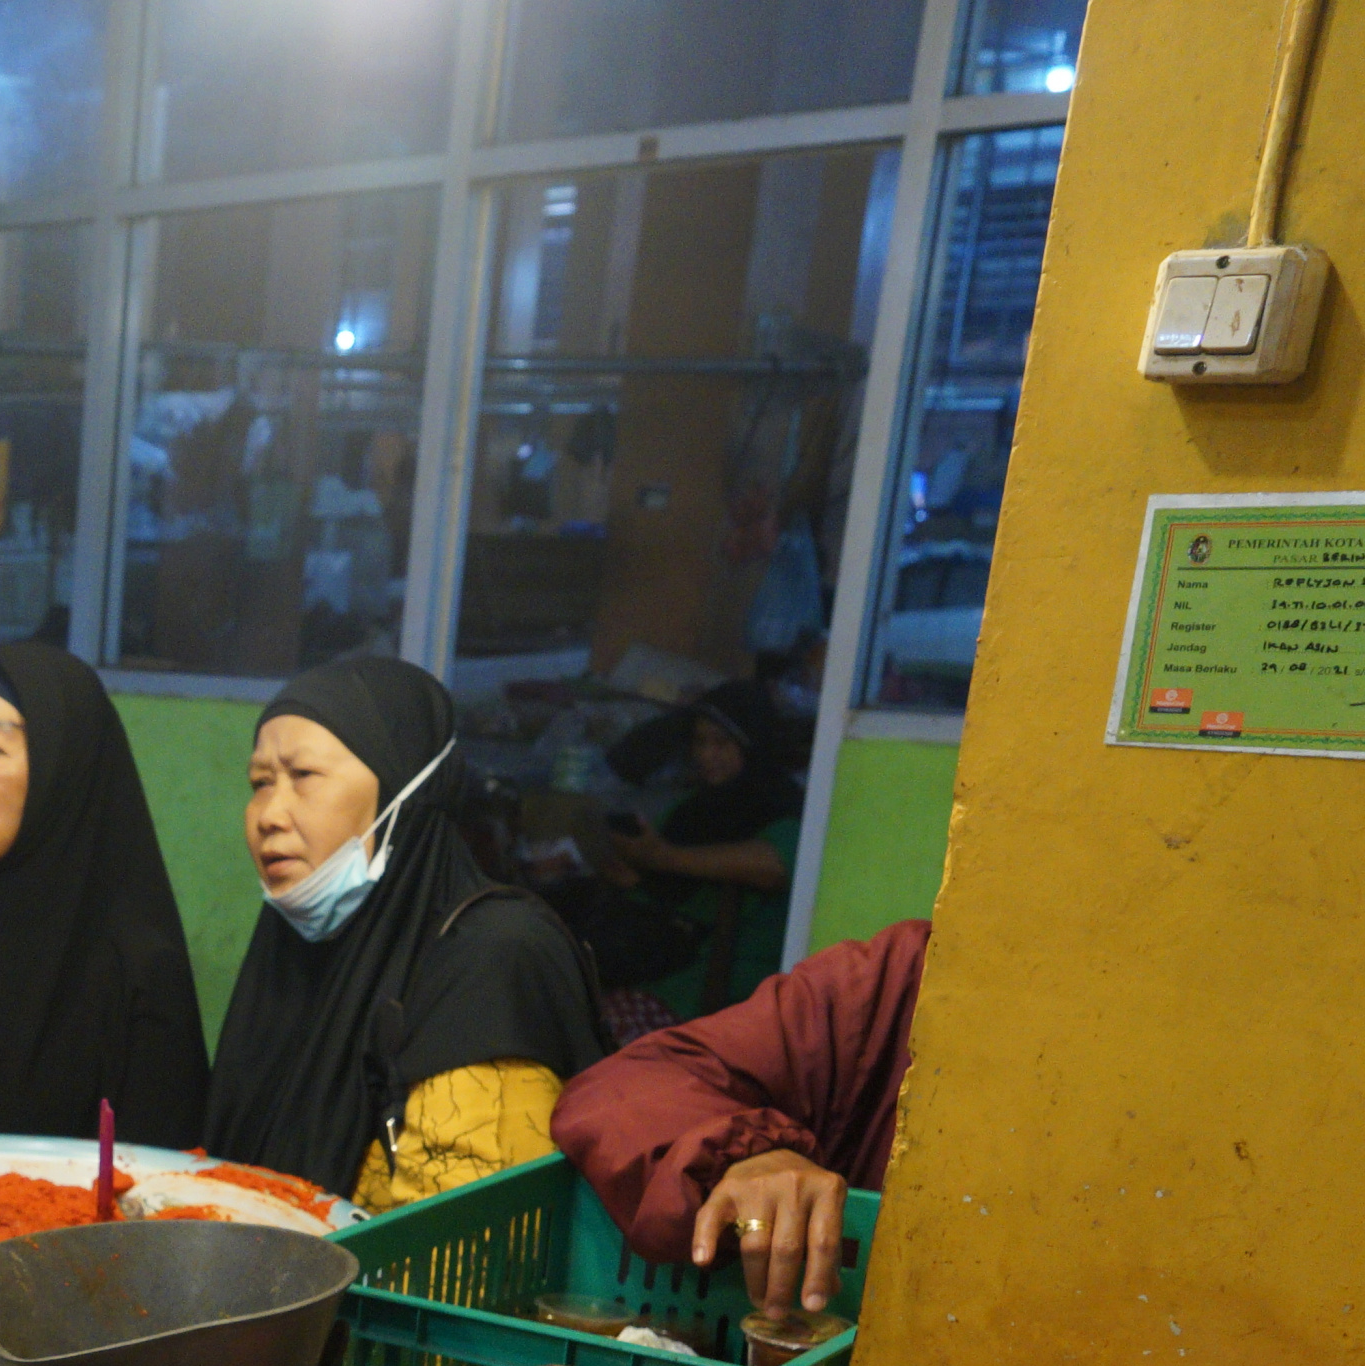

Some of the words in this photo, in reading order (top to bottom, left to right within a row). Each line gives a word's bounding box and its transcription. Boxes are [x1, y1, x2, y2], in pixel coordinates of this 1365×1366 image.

[1228, 538, 1320, 549] PEMERINTAH
[1324, 537, 1364, 548] KOTA
[1273, 553, 1318, 564] PASAR
[1177, 580, 1209, 590] Nama
[1173, 601, 1192, 610] NIL
[1170, 621, 1217, 633] Register
[1163, 663, 1192, 673] Masa
[1195, 664, 1238, 674] Berlaku
